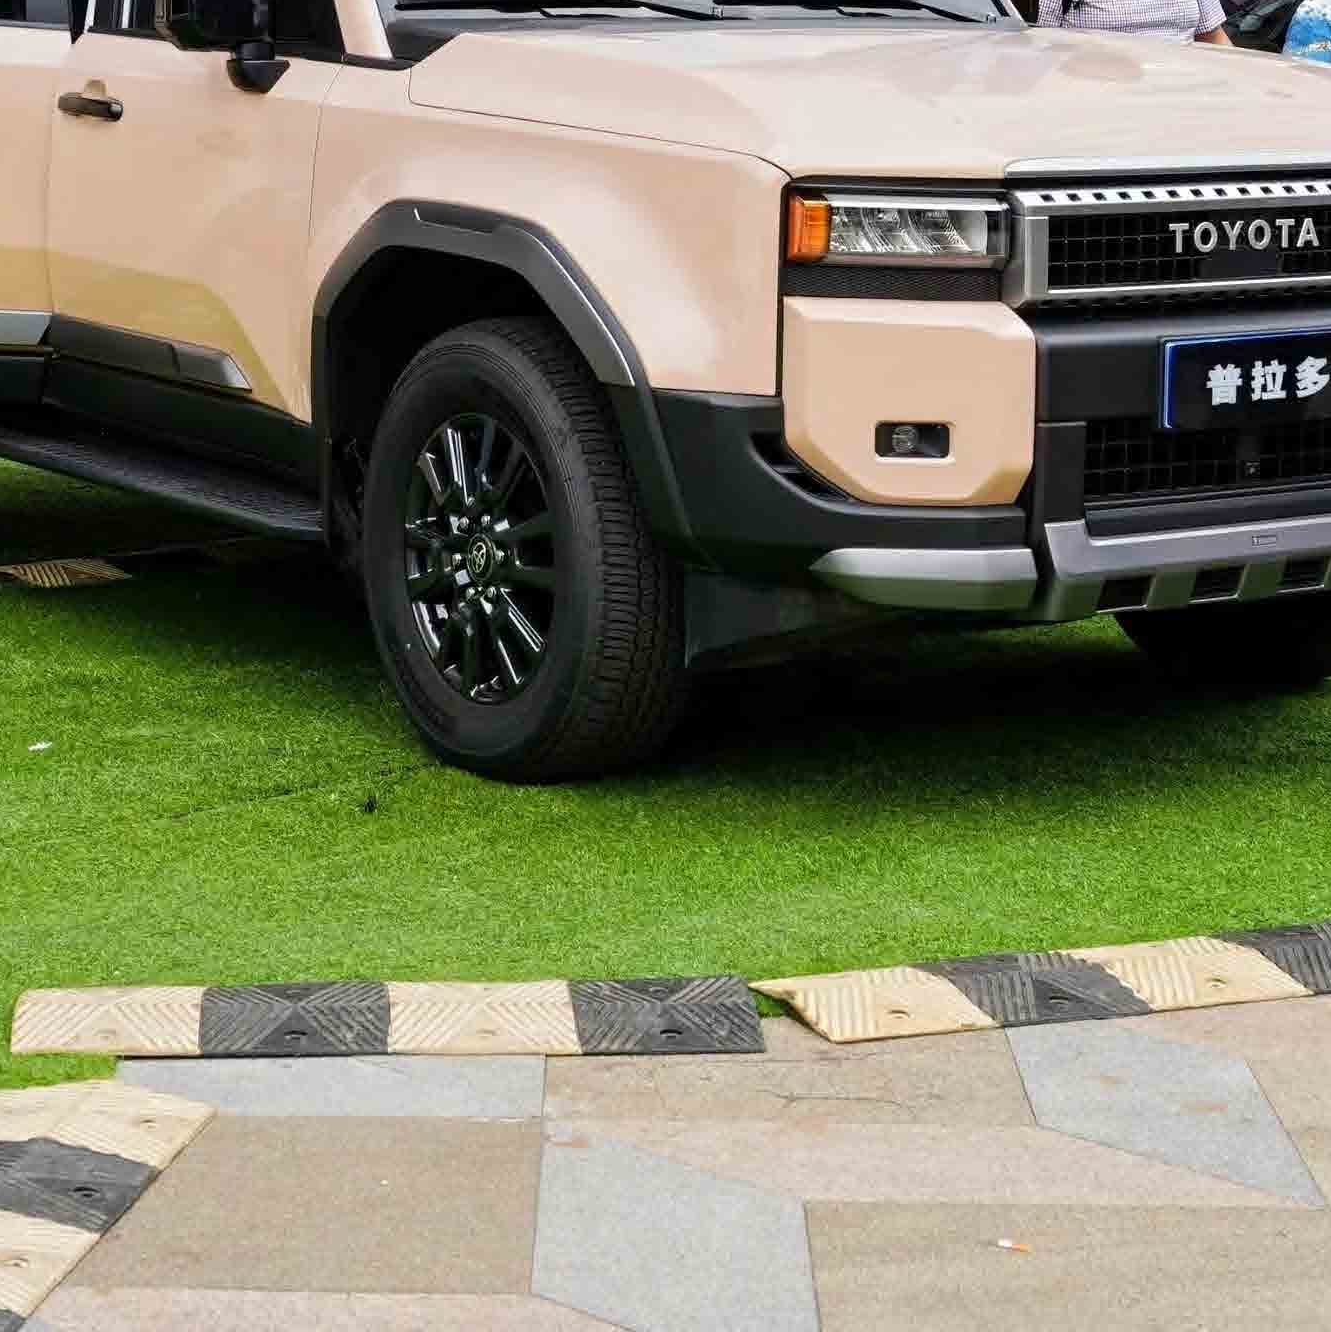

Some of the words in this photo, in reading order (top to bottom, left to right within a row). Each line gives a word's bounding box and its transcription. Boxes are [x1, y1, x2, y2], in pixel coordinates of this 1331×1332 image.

[1168, 216, 1320, 254] TOYOTA
[1205, 355, 1331, 406] 普拉多
